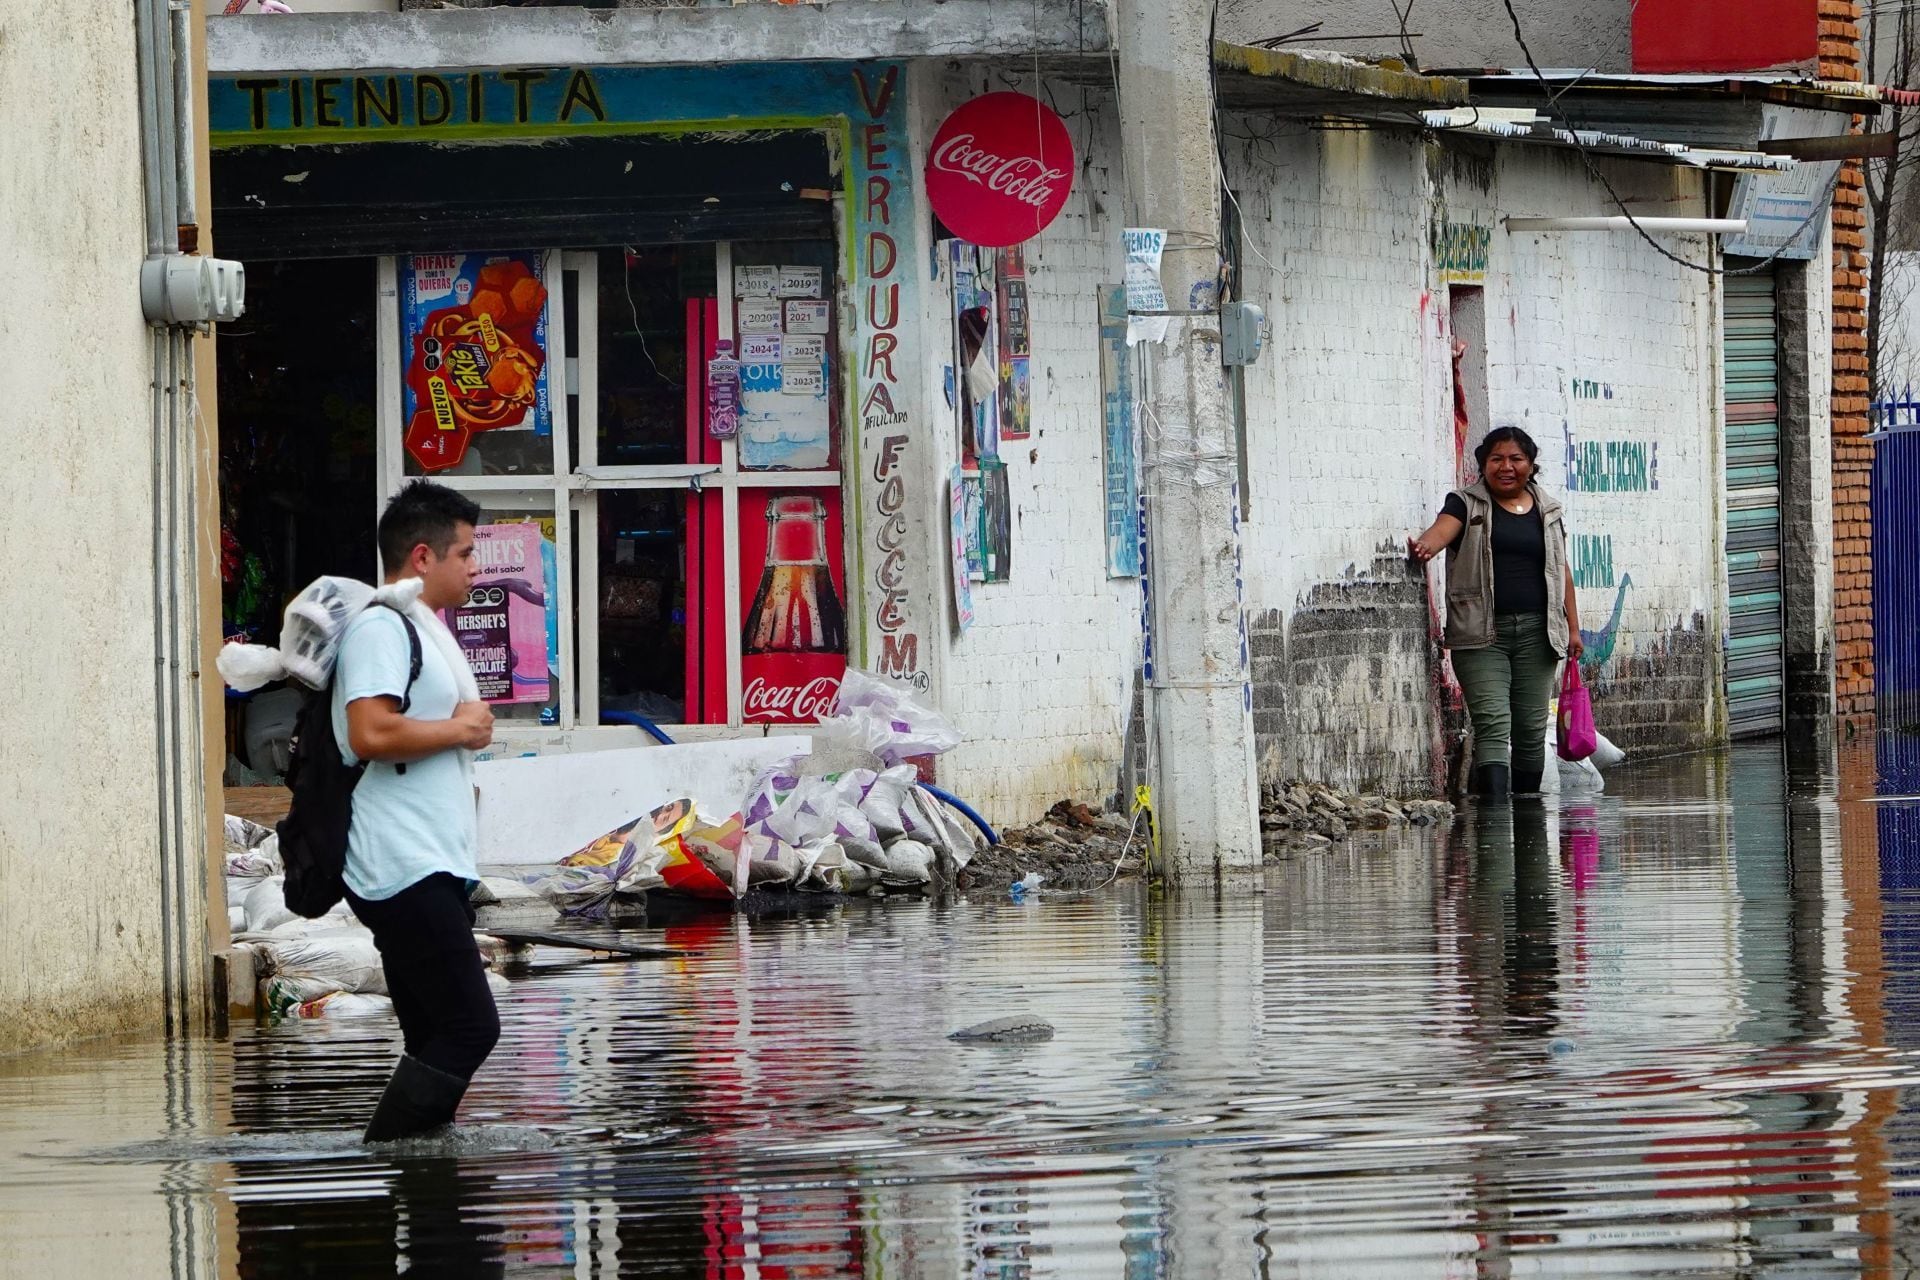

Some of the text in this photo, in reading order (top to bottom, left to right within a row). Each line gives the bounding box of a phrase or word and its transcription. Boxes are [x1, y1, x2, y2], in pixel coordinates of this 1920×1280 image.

[236, 69, 604, 130] TIENDITA
[934, 134, 1068, 206] Coca-Cola
[853, 65, 899, 417] VERDURA
[744, 281, 769, 289] 2018
[787, 279, 812, 288] 2019
[748, 314, 773, 323] 2020
[790, 313, 811, 321] 2021
[482, 319, 496, 346] QUESO
[749, 345, 772, 353] 2024
[794, 347, 815, 355] 2022
[793, 377, 813, 385] 2023
[431, 381, 451, 424] NUEVOS
[472, 539, 525, 565] SHEY'S
[880, 434, 918, 675] FOCCEM
[500, 566, 525, 574] sabor
[457, 614, 506, 630] HERSHEY'S
[743, 677, 841, 718] Coca-Col
